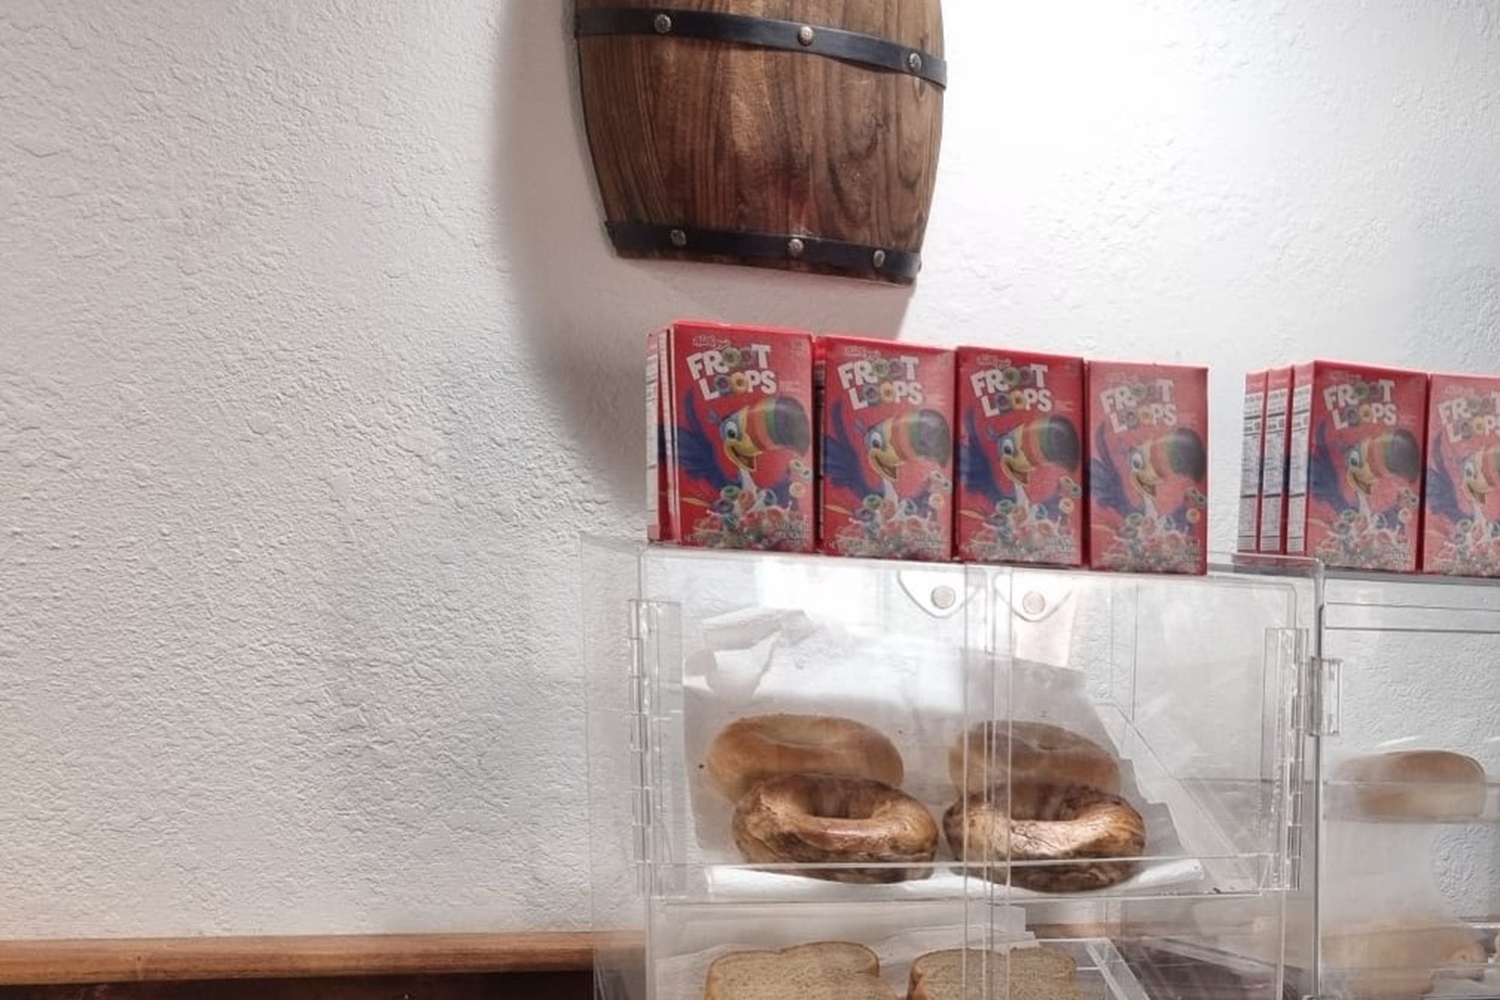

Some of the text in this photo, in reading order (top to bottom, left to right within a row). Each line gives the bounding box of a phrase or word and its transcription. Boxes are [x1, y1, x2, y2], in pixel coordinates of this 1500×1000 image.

[686, 344, 771, 380] FROOT
[838, 355, 919, 390] FROOT
[699, 370, 777, 400] LOOPS
[848, 381, 923, 411] LOOPS
[970, 364, 1048, 398] FROOT
[1100, 379, 1174, 413] FROOT
[1323, 379, 1395, 411] FROOT
[981, 388, 1052, 417] LOOPS
[1110, 403, 1177, 433] LOOPS
[1332, 402, 1397, 430] LOOPS
